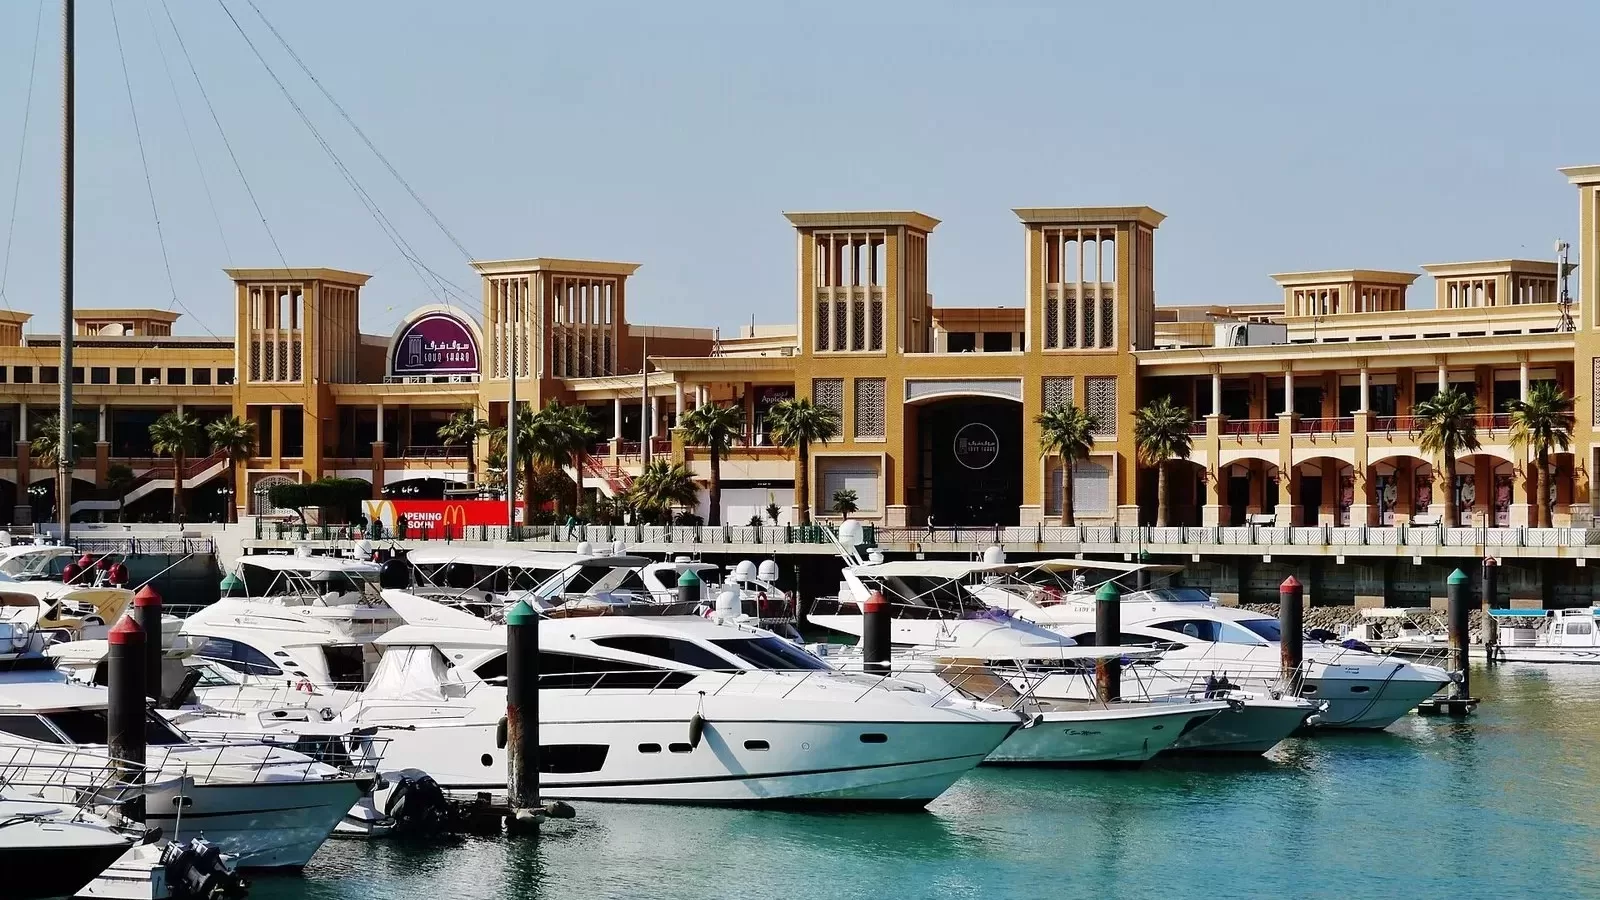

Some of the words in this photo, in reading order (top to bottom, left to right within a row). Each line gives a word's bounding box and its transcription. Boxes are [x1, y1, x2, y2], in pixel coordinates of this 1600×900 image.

[424, 340, 446, 351] شرق
[446, 340, 470, 351] سوق
[424, 352, 442, 362] SOUQ
[446, 352, 470, 362] SHARQ
